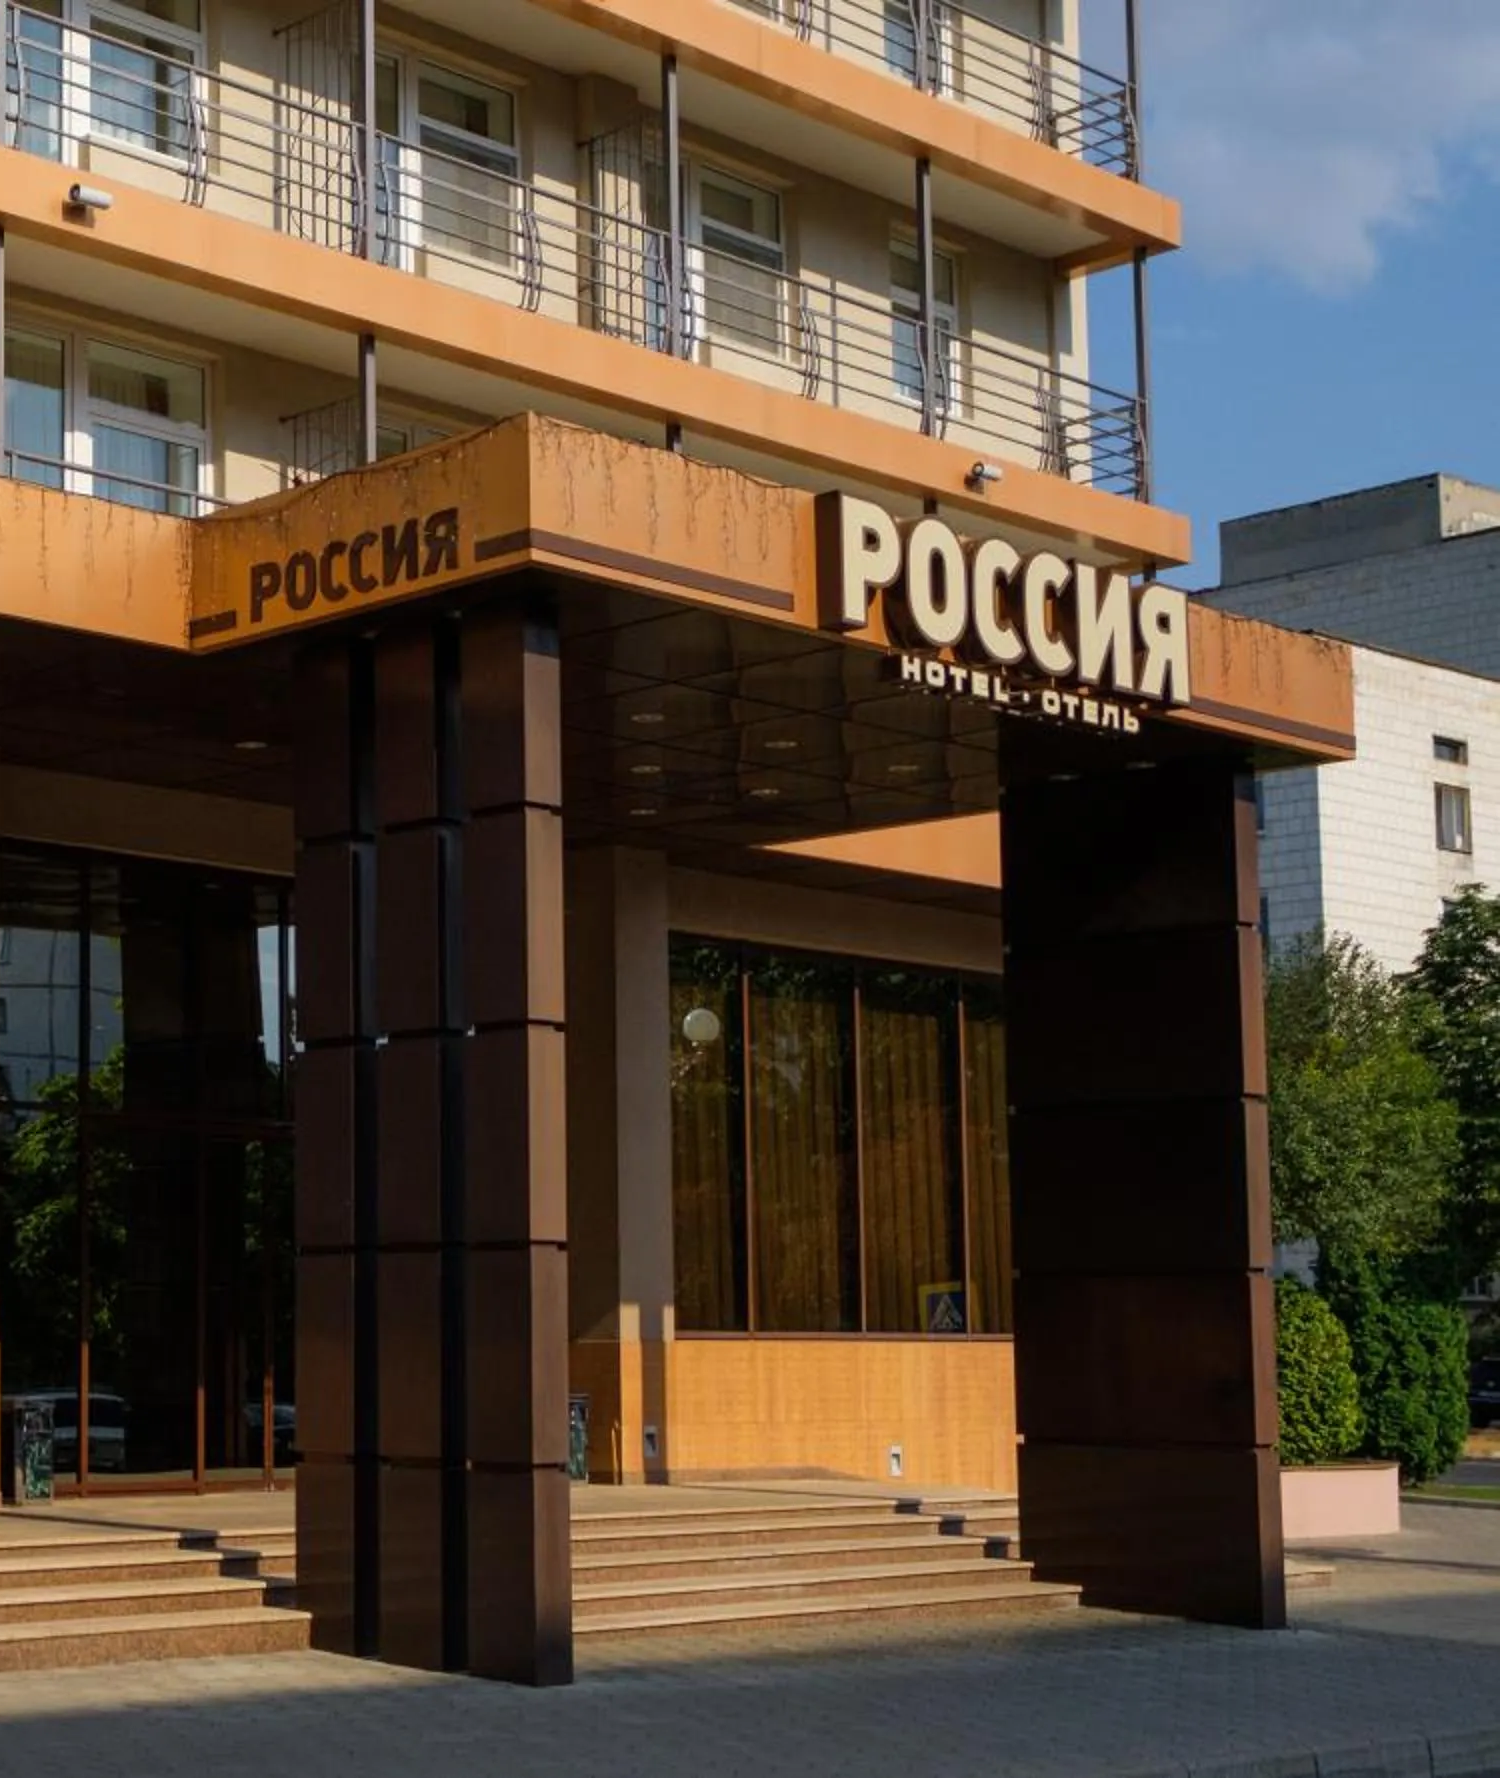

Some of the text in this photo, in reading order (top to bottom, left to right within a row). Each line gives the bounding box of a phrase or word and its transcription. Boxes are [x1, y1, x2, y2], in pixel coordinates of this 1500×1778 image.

[249, 507, 460, 624] РОССИЯ
[841, 493, 1191, 705] РОССИЯ
[901, 655, 1141, 734] HOTEL ОТЕЛЬ
